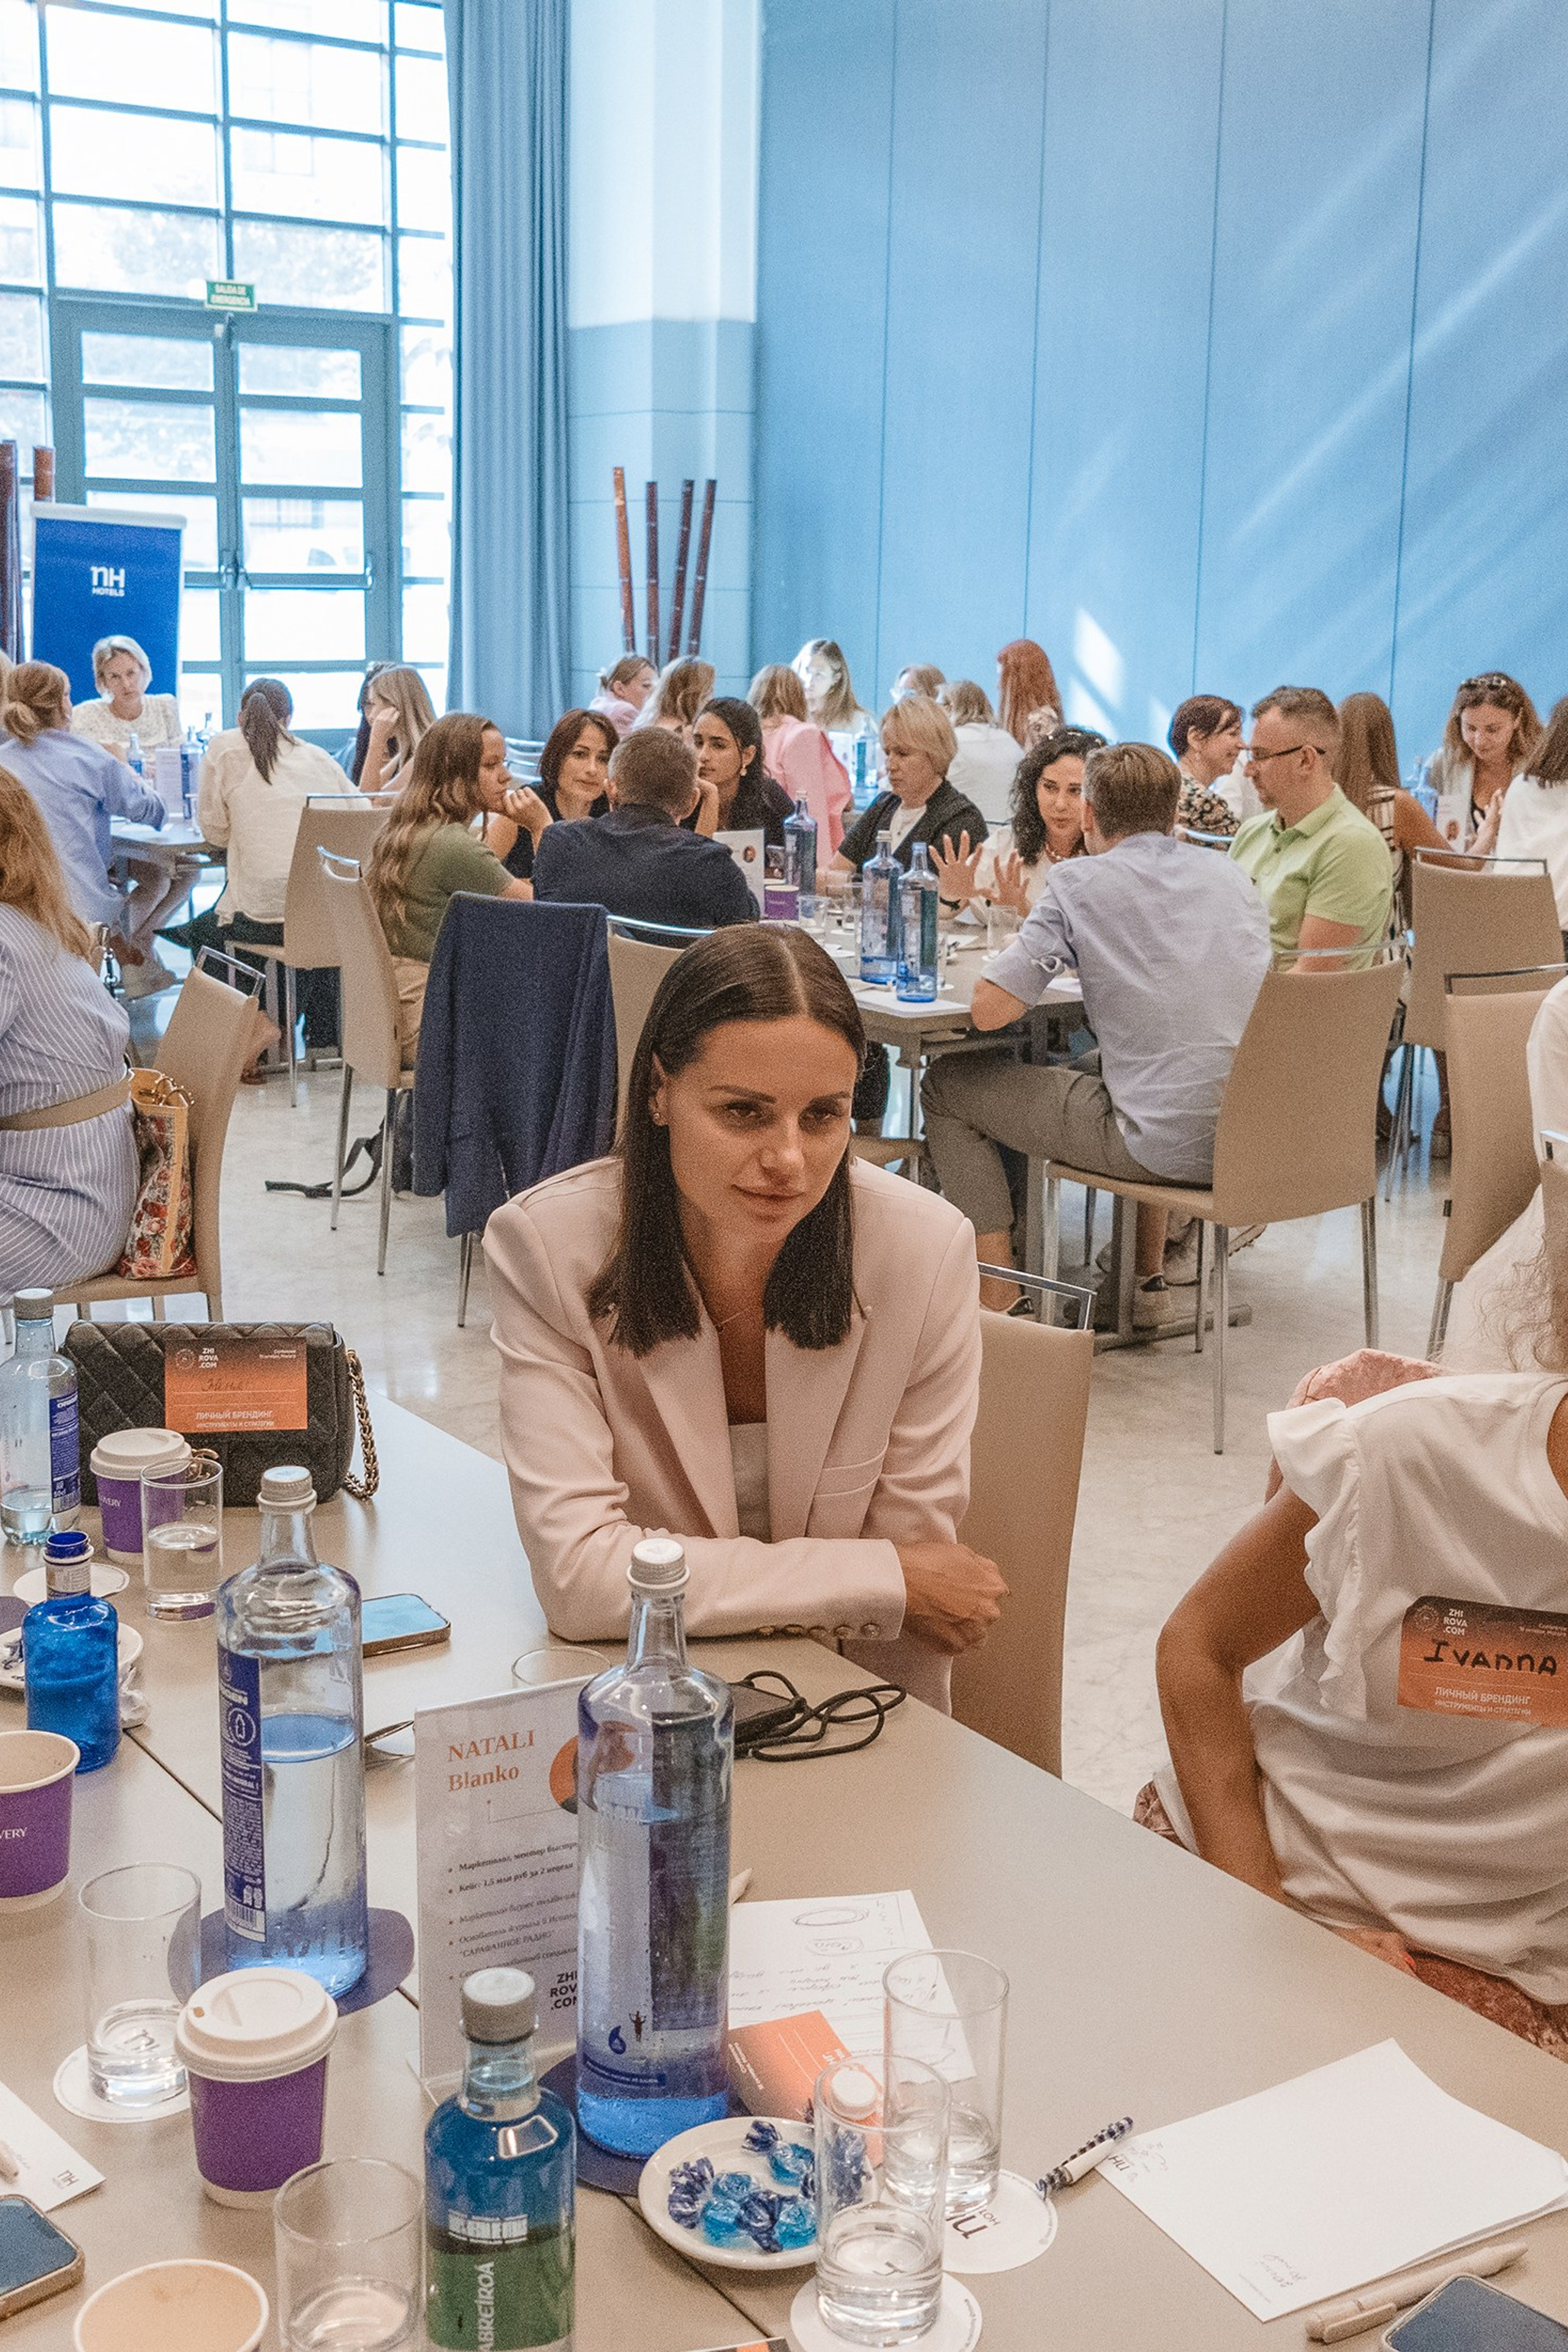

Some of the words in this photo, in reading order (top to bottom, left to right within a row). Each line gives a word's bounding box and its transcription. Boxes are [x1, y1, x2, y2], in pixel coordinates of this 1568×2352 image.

[92, 587, 125, 597] HOTELS
[196, 1411, 230, 1420] ЛИЧНЫЙ
[233, 1411, 272, 1419] БРЕНДИНГ
[1449, 1608, 1463, 1617] ZHI
[1444, 1617, 1468, 1627] ROVA
[1443, 1626, 1465, 1635] .COM
[1434, 1686, 1478, 1701] ЛИЧНЫЙ
[1480, 1692, 1531, 1705] БРЕНДИНГ
[448, 1729, 535, 1762] NATALI
[448, 1765, 519, 1792] Blanko
